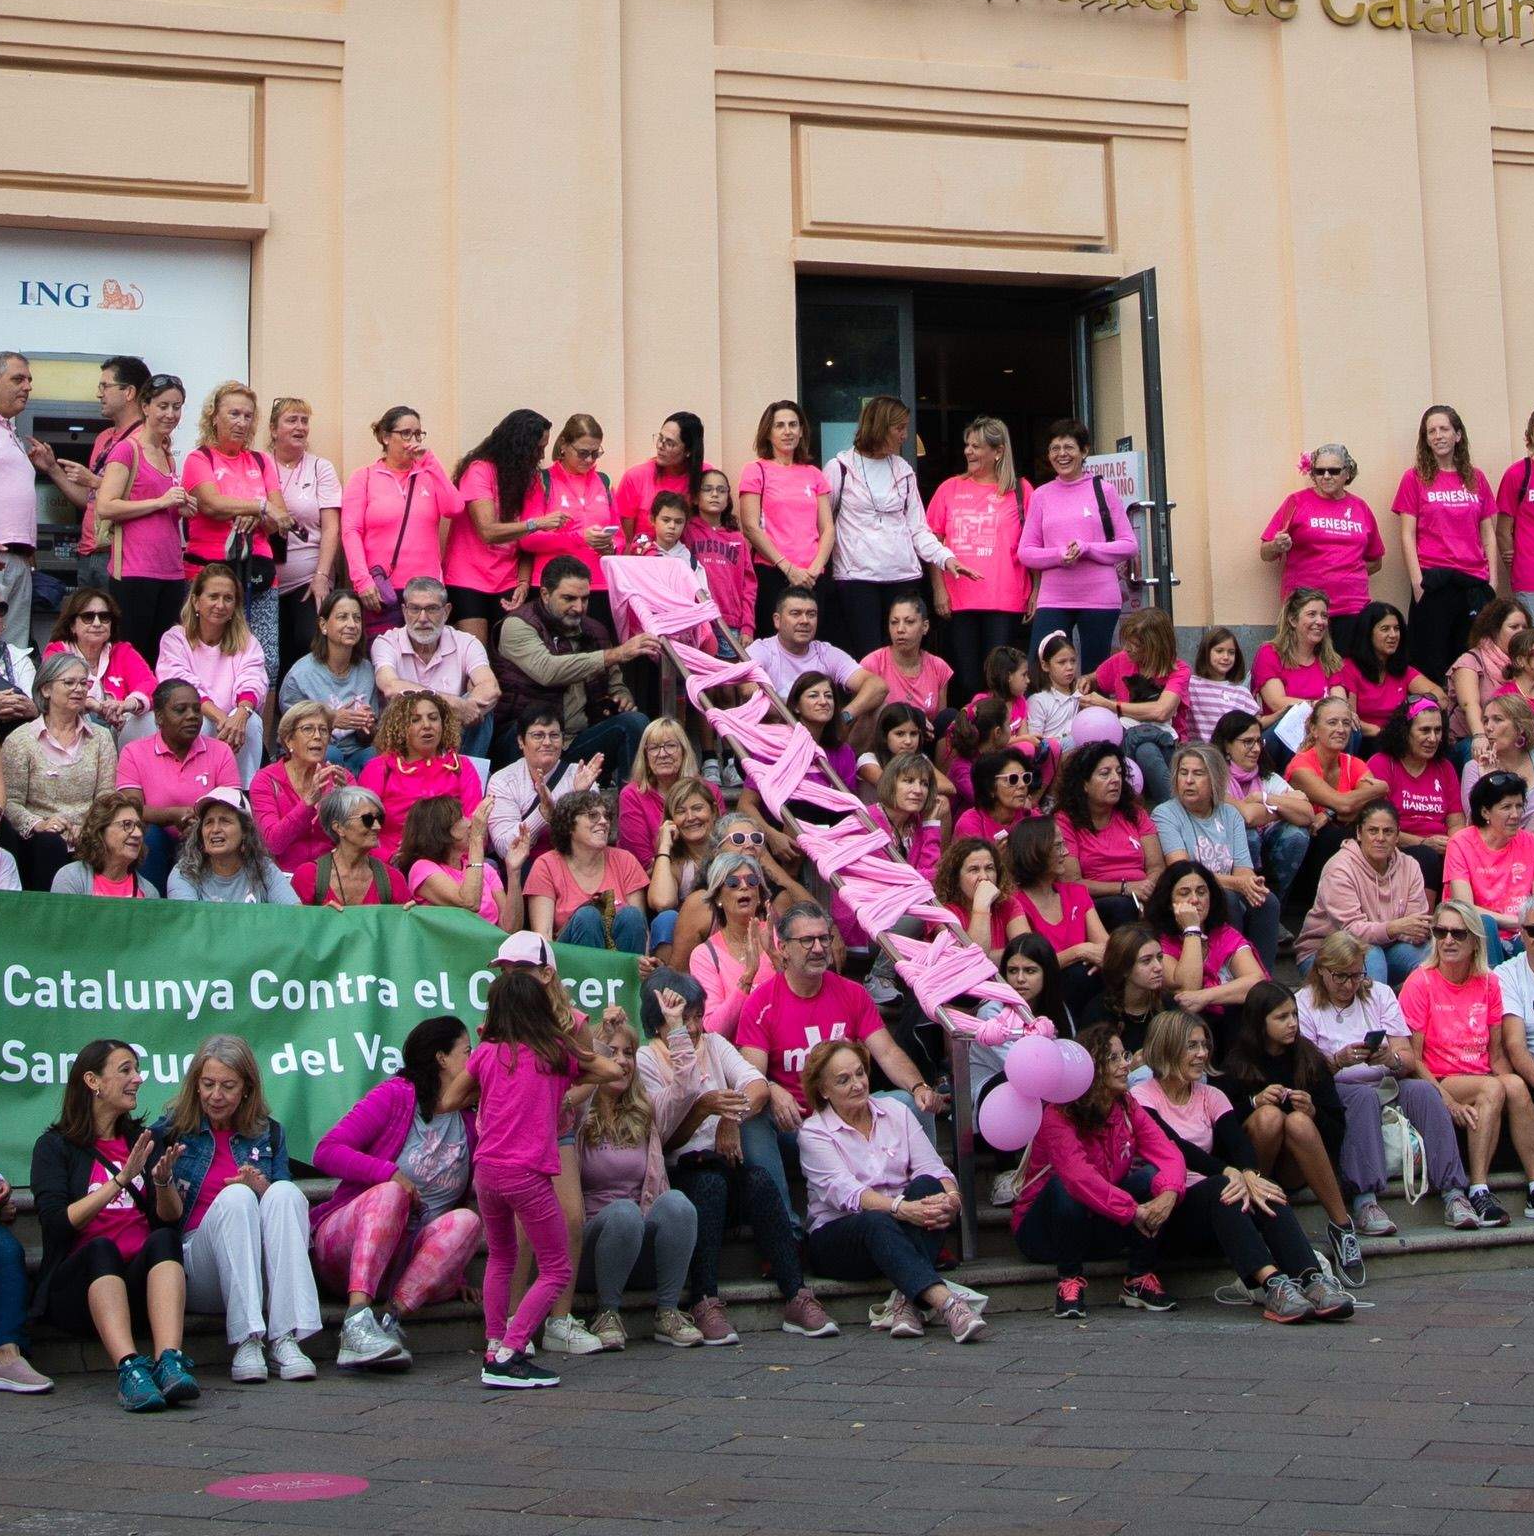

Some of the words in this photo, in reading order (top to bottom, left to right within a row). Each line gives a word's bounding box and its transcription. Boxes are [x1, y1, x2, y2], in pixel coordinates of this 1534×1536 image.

[18, 280, 91, 308] ING
[1116, 461, 1127, 476] DE
[1310, 517, 1363, 533] BENESFIT
[1402, 800, 1444, 813] HANDBOL
[3, 964, 235, 1020] Catalunya
[249, 968, 399, 1012] Contra
[413, 970, 456, 1011] el
[468, 970, 624, 1011] Ccer
[0, 1039, 69, 1084] San
[270, 1037, 344, 1077] del
